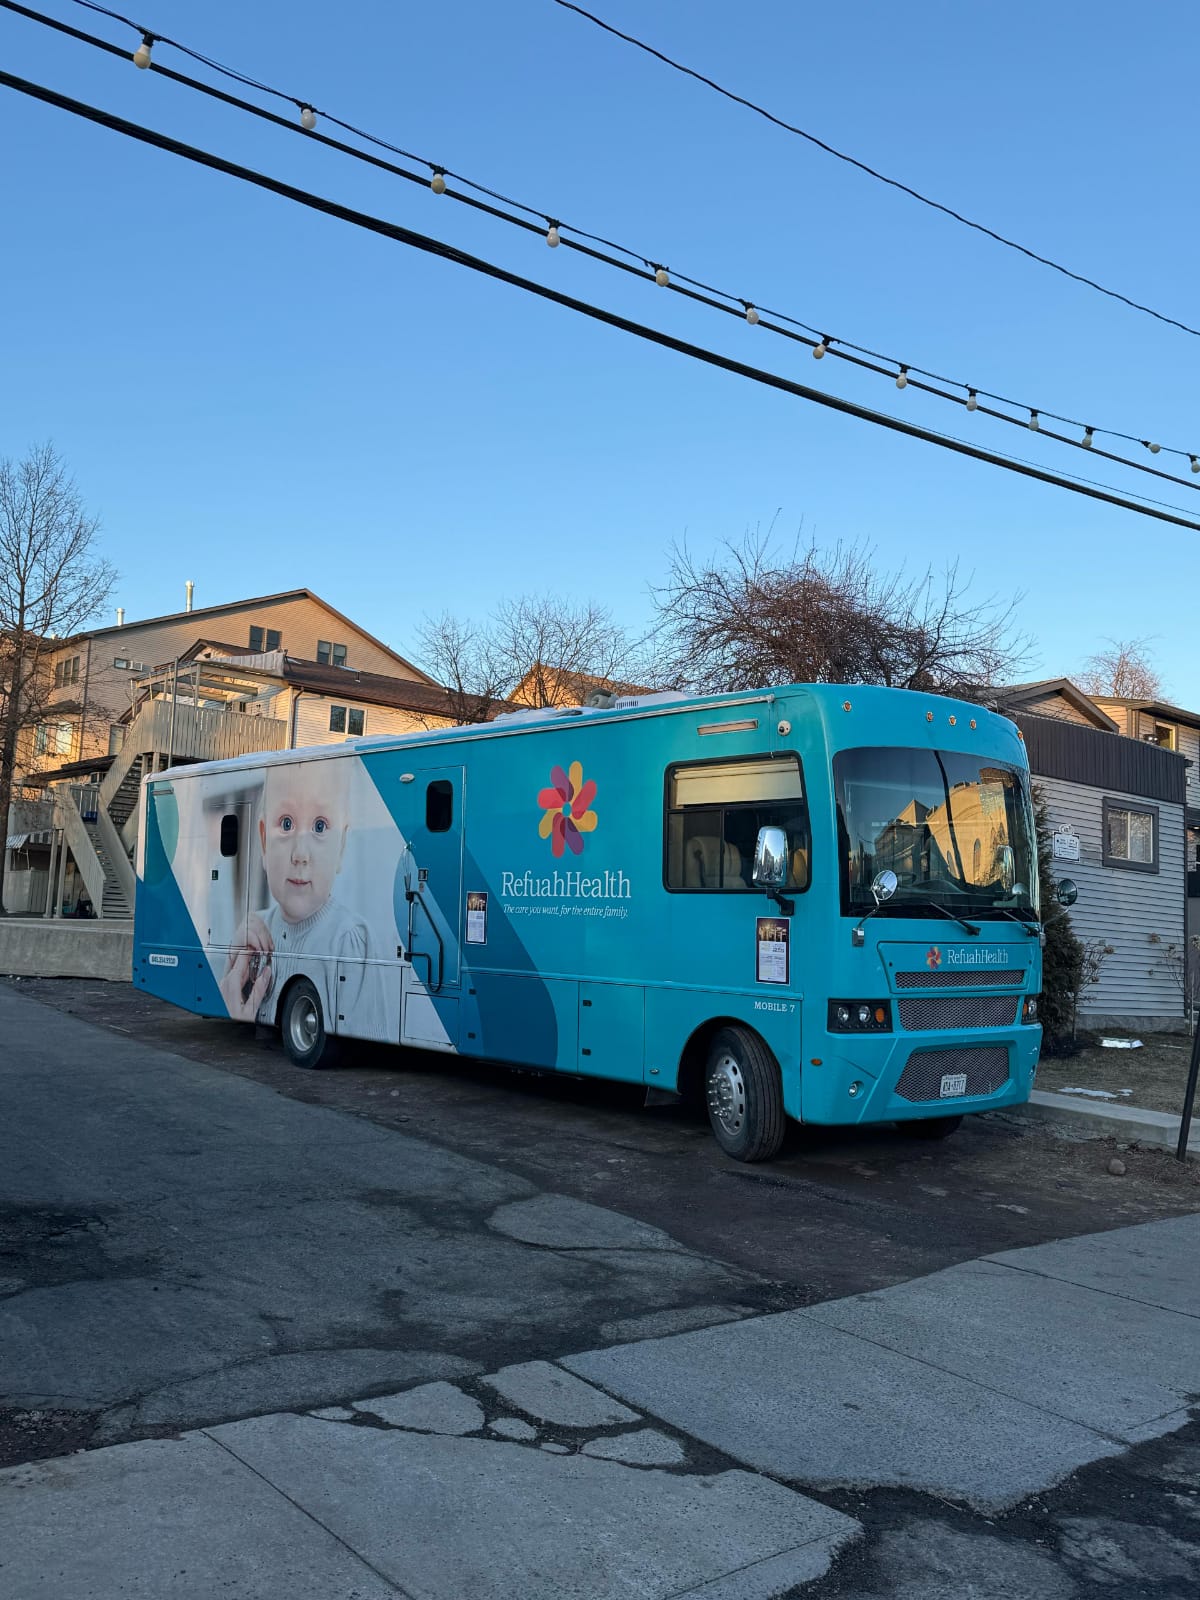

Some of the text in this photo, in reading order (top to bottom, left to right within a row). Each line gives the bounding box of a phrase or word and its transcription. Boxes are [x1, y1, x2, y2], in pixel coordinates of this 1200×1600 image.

[501, 870, 632, 898] RefuahHealth
[503, 904, 514, 914] The
[515, 906, 528, 914] care
[529, 906, 541, 916] you
[559, 904, 572, 917] for
[572, 905, 583, 915] the
[583, 906, 603, 916] entire
[947, 948, 1009, 964] RefuahHealth
[754, 1001, 795, 1012] MOBILE 7
